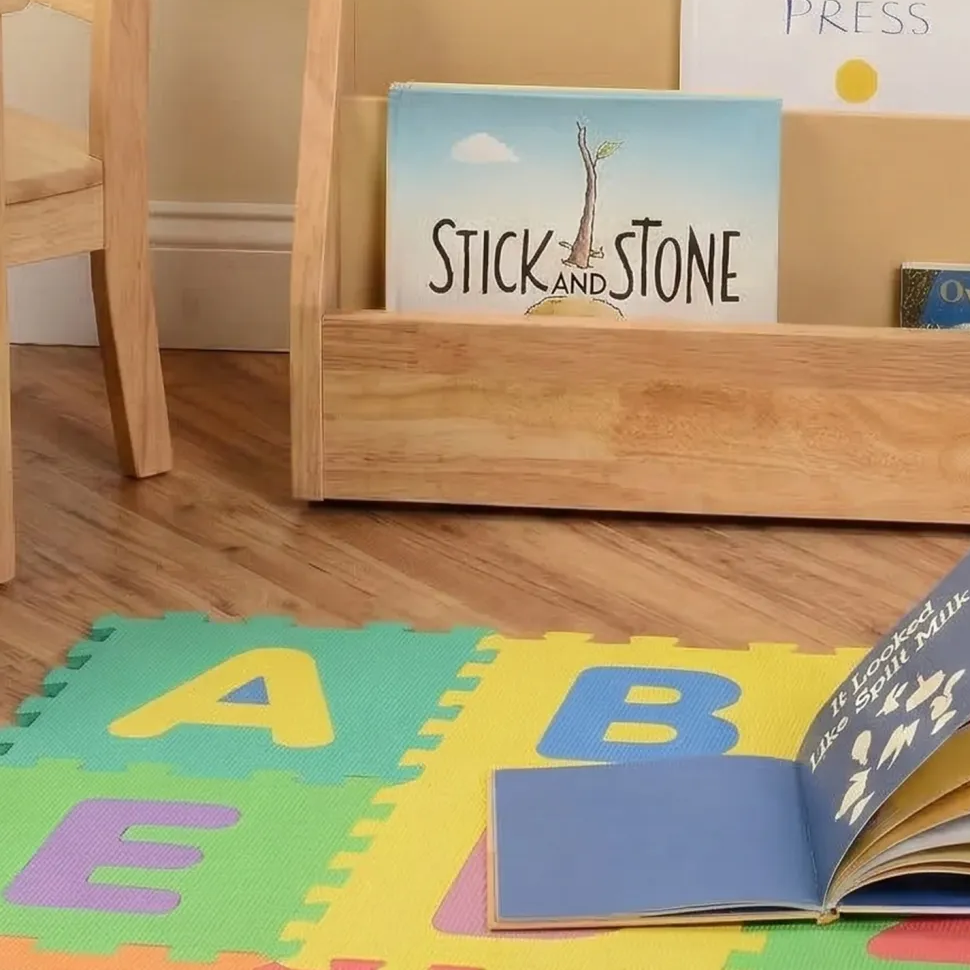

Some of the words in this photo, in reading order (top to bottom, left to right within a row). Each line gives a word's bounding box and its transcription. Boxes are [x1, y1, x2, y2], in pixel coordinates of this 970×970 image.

[428, 218, 554, 295] STICK
[551, 271, 607, 295] AND
[609, 217, 742, 306] STONE
[831, 690, 848, 718] It
[851, 600, 935, 696] Looked
[914, 589, 970, 652] Milk
[108, 647, 335, 749] A
[535, 666, 742, 762] B
[4, 798, 241, 915] E
